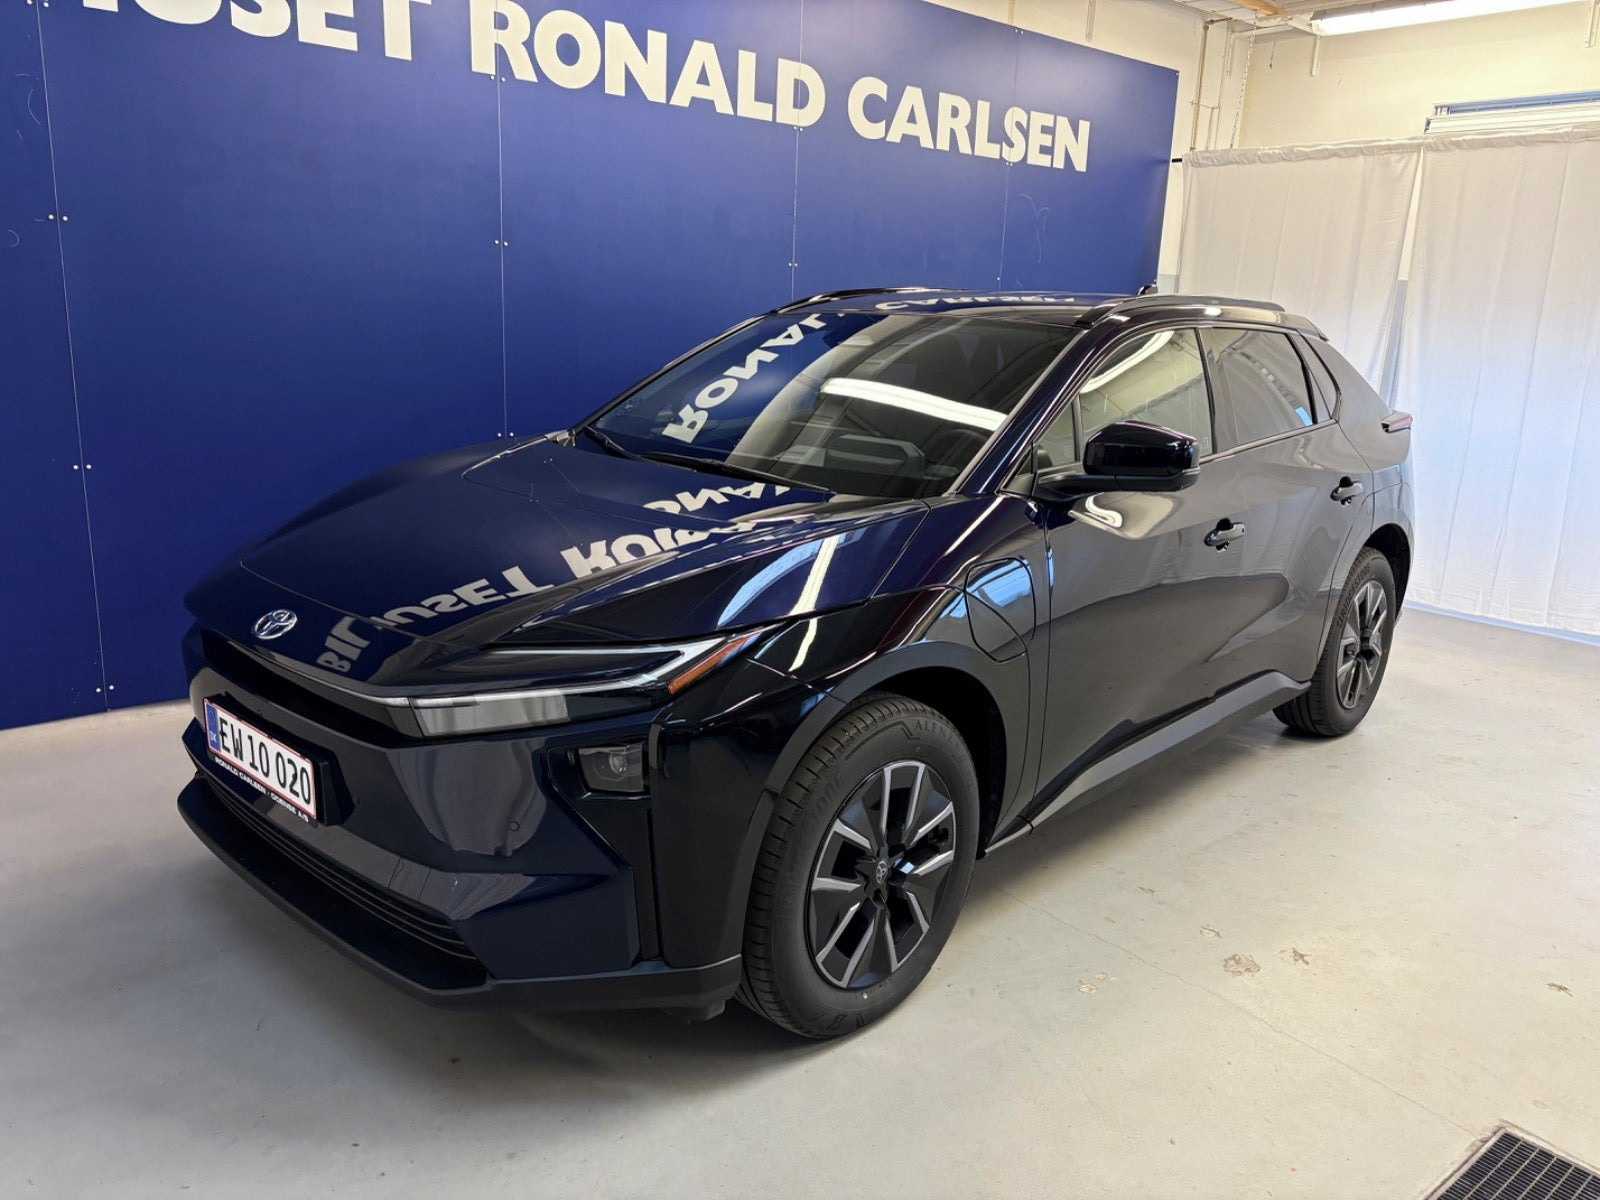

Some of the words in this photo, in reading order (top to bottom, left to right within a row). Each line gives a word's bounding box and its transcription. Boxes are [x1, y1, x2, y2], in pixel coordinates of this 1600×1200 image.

[469, 0, 826, 127] RONALD
[848, 76, 1091, 173] CARLSEN
[219, 717, 243, 762] EW
[247, 734, 270, 778] 10
[275, 751, 311, 805] 020
